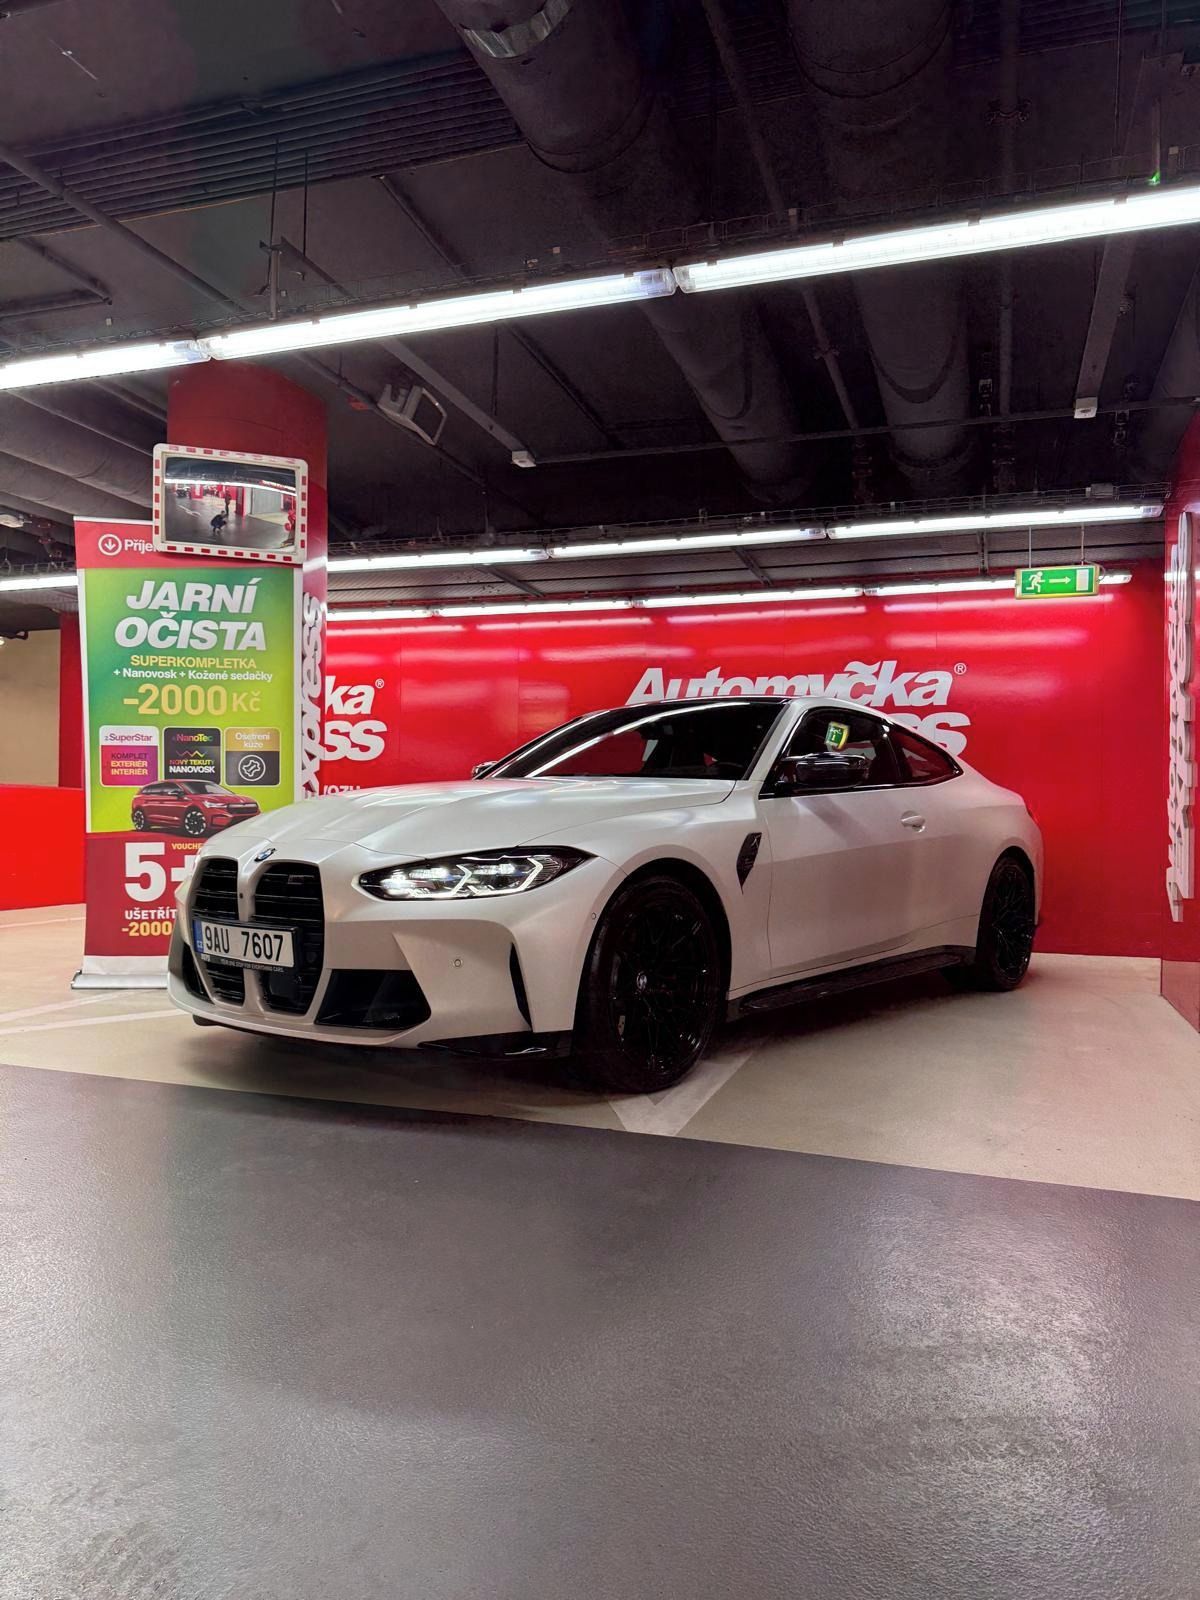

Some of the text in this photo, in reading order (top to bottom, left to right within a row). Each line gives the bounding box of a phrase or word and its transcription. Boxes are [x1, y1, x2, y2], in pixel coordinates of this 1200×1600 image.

[126, 577, 262, 613] JARNÍ
[114, 611, 267, 651] OČISTA
[130, 655, 256, 669] SUPERKOMPLETKA
[123, 668, 177, 679] Nanovosk
[188, 670, 228, 680] Kožené
[230, 670, 273, 682] sedačky
[123, 683, 261, 716] -2000 Kč
[176, 733, 213, 742] NanoTec
[111, 752, 148, 760] KOMPLET
[169, 765, 215, 774] NANOVOSK
[124, 907, 178, 920] UŠETŘÍT
[204, 925, 230, 954] 9AU
[241, 931, 284, 962] 7607
